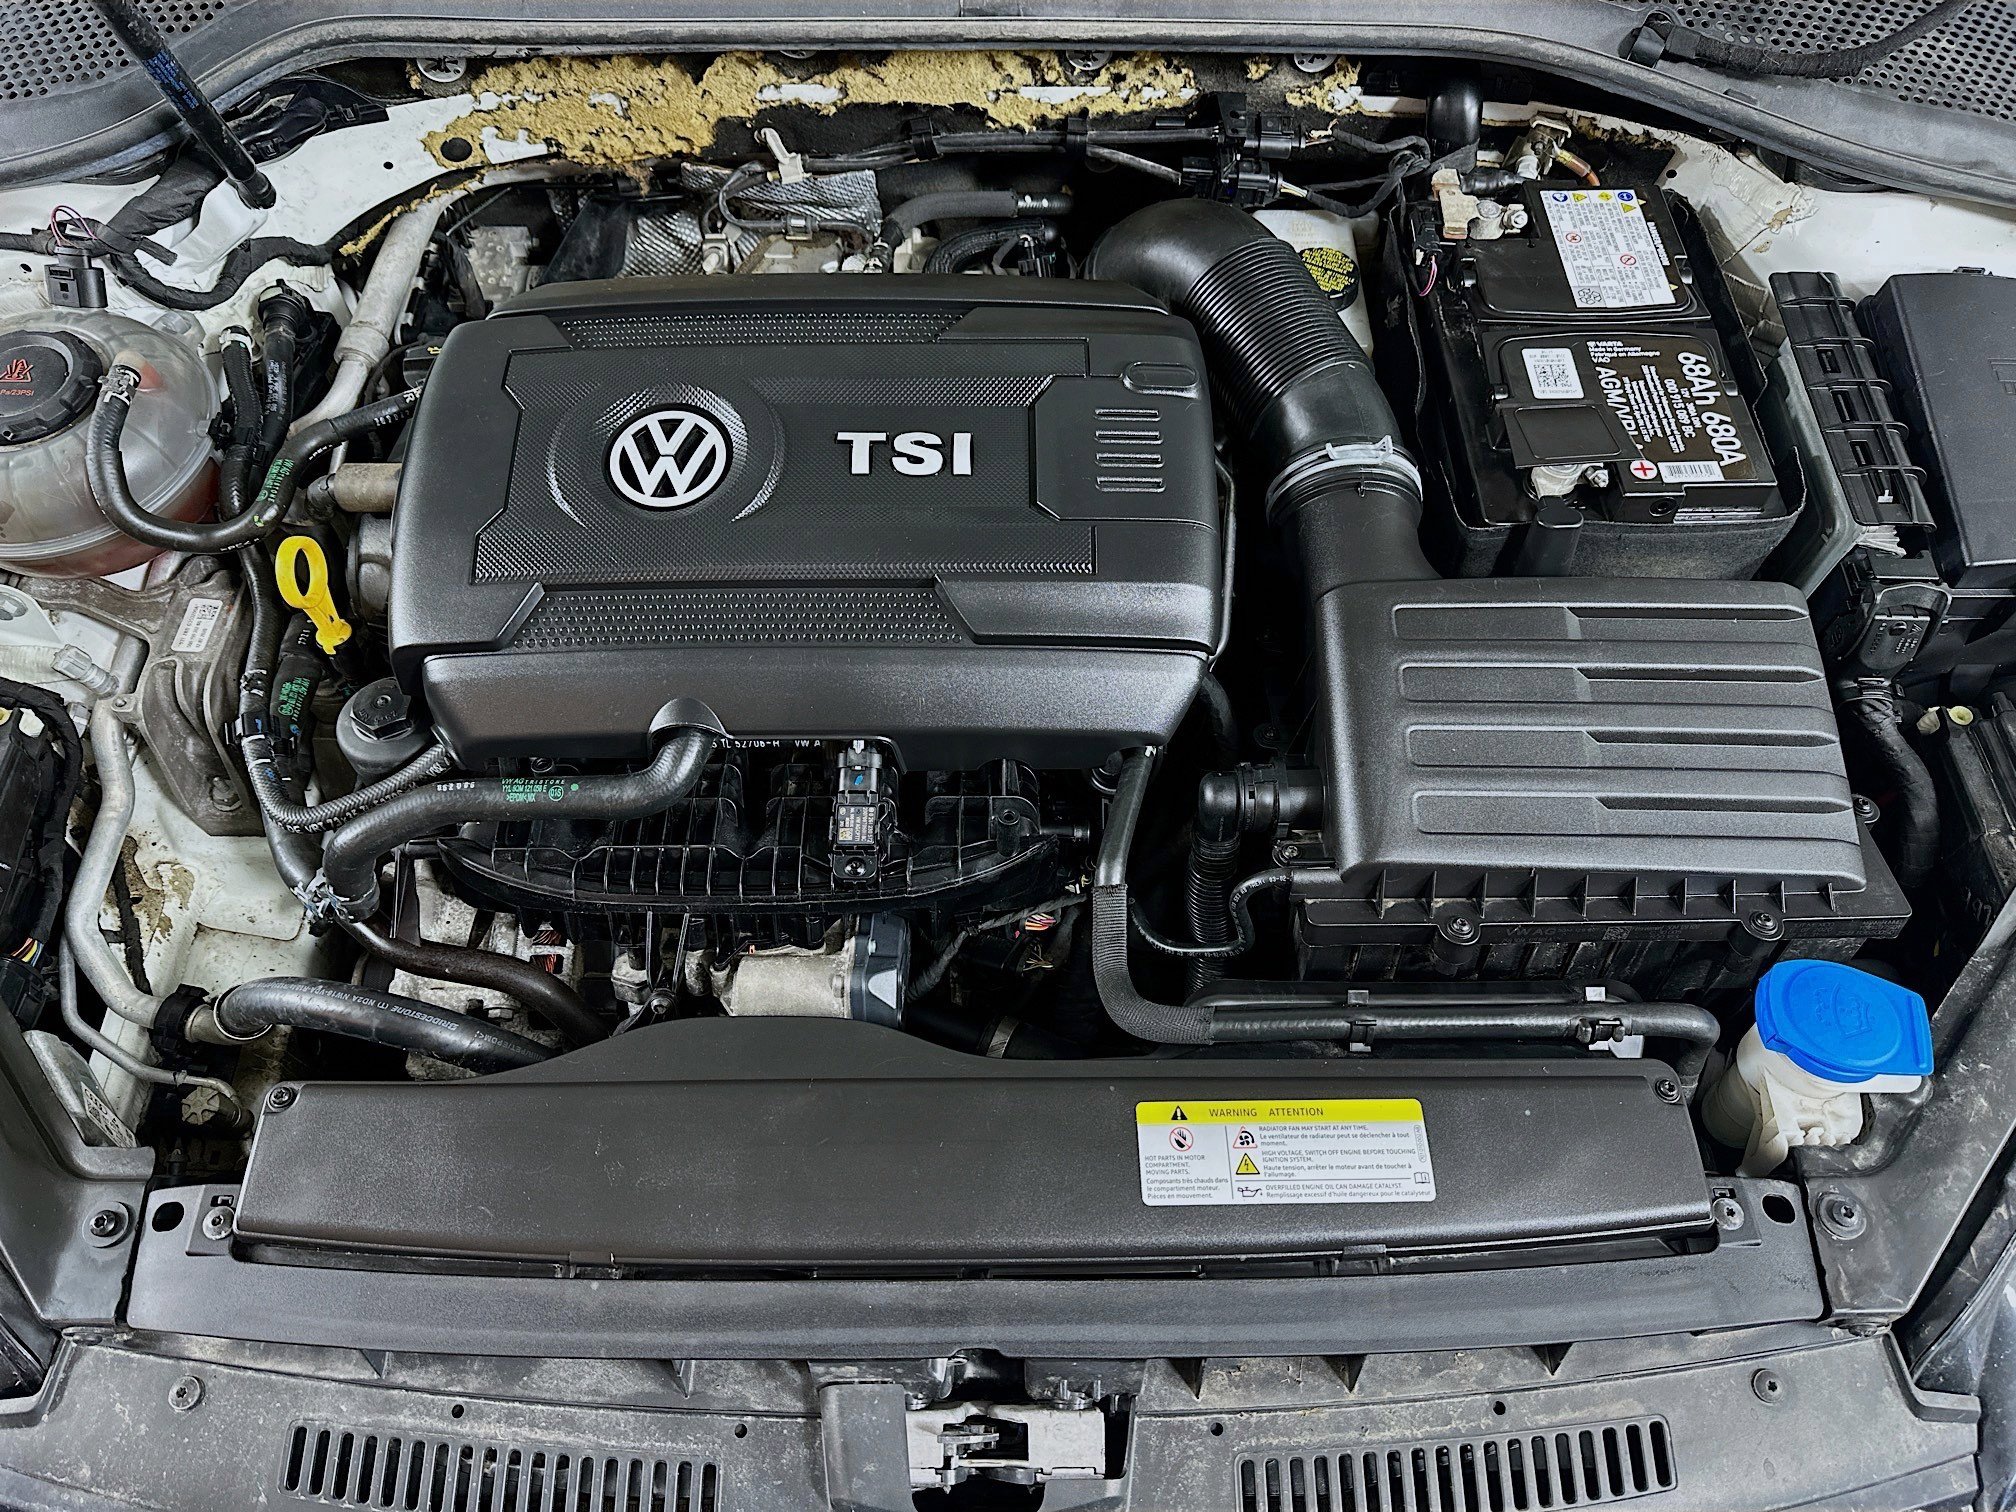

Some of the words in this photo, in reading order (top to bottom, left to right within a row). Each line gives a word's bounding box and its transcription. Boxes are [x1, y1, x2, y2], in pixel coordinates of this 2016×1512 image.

[1664, 379, 1679, 394] 000
[1670, 394, 1685, 408] 915
[1678, 352, 1720, 405] 68Ah
[1701, 412, 1746, 466] 680A
[1682, 426, 1696, 438] BC
[837, 431, 973, 476] TSI
[350, 995, 376, 1006] ND2A
[390, 1004, 459, 1031] BRIDGESTONE
[1209, 1108, 1258, 1117] WARNING
[1268, 1107, 1324, 1117] ATTENTION
